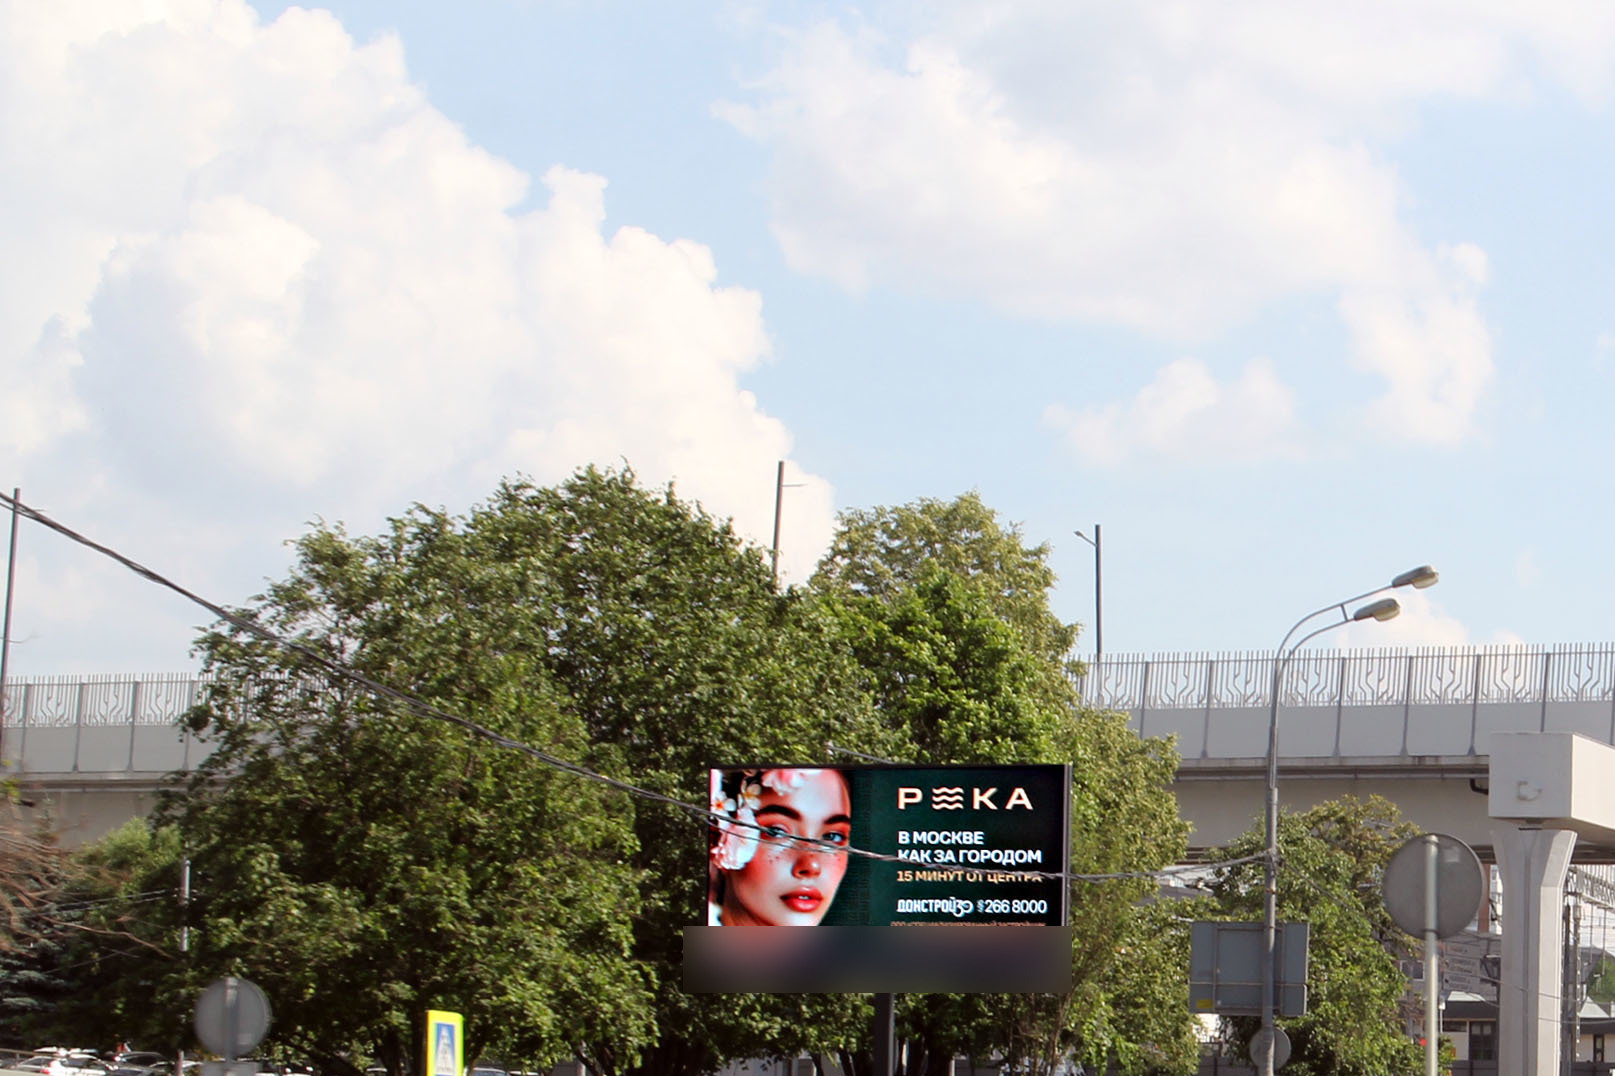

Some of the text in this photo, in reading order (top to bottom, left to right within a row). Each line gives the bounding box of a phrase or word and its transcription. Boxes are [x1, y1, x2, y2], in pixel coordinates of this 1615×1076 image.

[898, 831, 985, 845] В МОСКВЕ
[898, 849, 1042, 866] КАК ЗА ГОРОДОМ
[897, 870, 912, 882] 15
[915, 870, 964, 882] МИНУТ
[985, 899, 1010, 913] 266
[1012, 899, 1048, 913] 8000
